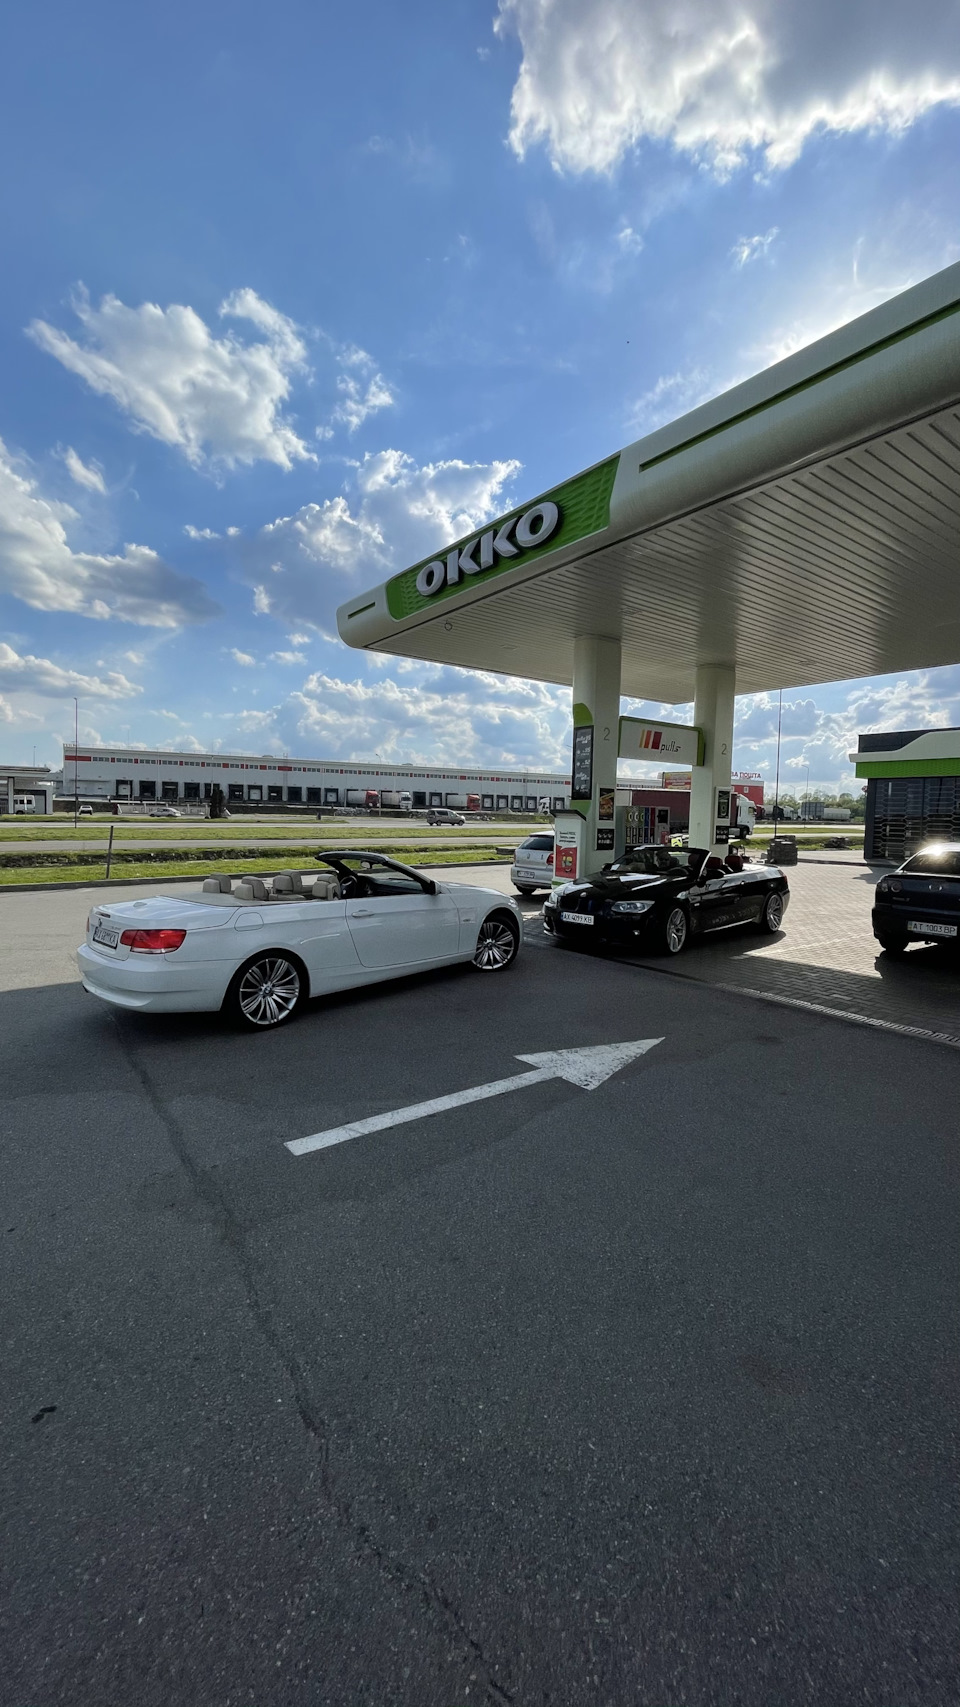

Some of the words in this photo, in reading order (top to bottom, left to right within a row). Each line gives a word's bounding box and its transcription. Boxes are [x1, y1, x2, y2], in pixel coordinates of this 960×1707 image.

[416, 501, 559, 596] OKKO
[603, 726, 611, 741] 2
[660, 740, 681, 754] pulls
[721, 743, 728, 755] 2
